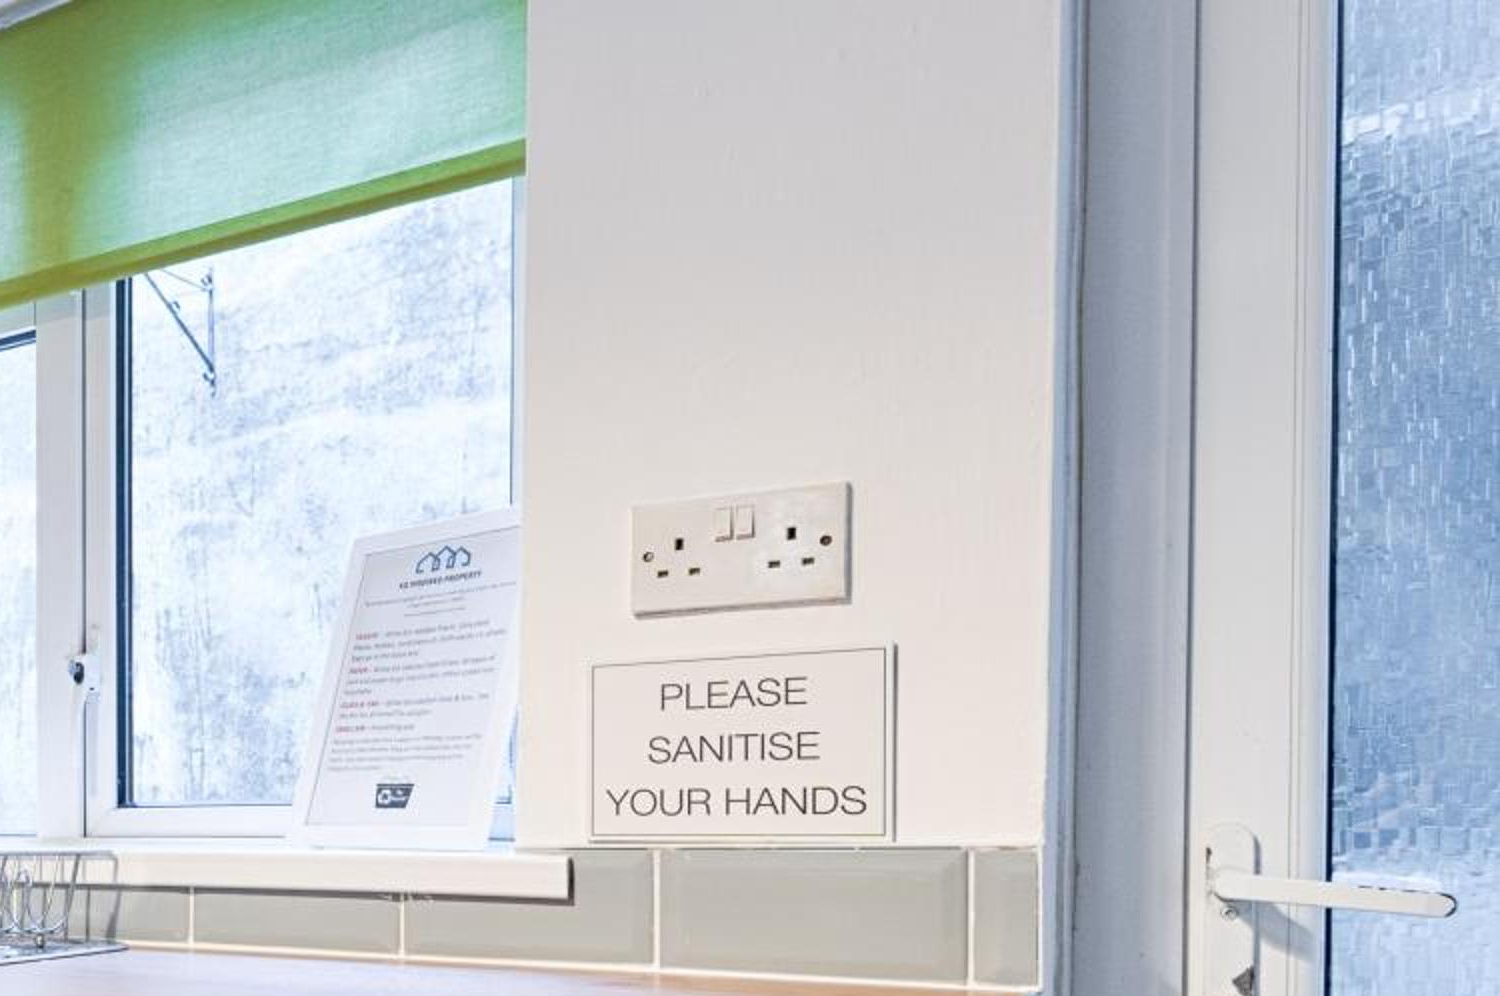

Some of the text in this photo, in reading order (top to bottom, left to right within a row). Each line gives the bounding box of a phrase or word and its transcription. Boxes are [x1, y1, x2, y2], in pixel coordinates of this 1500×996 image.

[660, 676, 808, 711] PLEASE
[648, 731, 820, 765] SANITISE
[606, 785, 867, 817] YOUR HANDS
